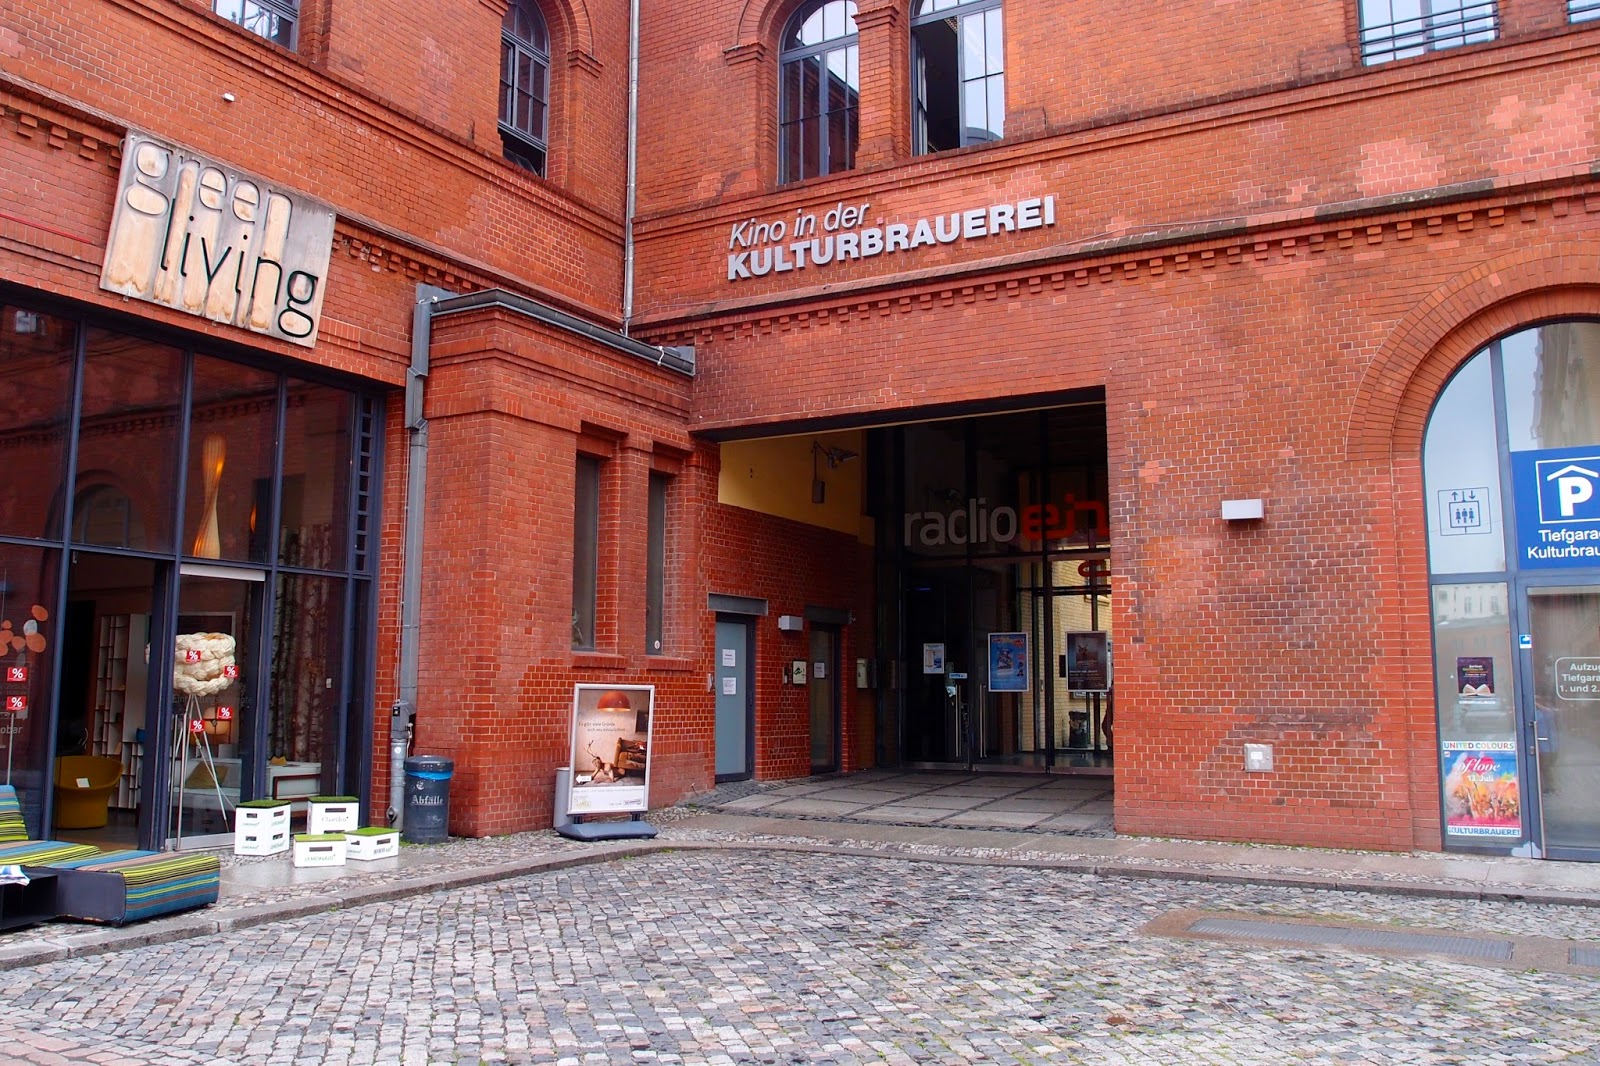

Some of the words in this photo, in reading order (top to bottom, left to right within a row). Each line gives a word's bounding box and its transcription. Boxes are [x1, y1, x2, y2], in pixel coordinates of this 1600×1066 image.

[126, 141, 294, 240] green
[728, 217, 787, 251] Kino
[793, 208, 816, 238] in
[822, 202, 871, 232] der
[726, 195, 1056, 281] KULTURBRAUEREI
[160, 198, 319, 338] living
[1537, 528, 1600, 544] Tiefgara
[1559, 685, 1568, 693] 1.
[1570, 684, 1589, 693] und
[1591, 685, 1600, 693] 2.
[1443, 742, 1474, 750] UNITED
[1475, 742, 1515, 750] COLOURS
[1458, 758, 1476, 776] of
[1474, 758, 1501, 772] love
[1479, 774, 1494, 782] Juli
[410, 794, 444, 806] Abfälle
[1448, 826, 1520, 837] KULTURBRAUEREI
